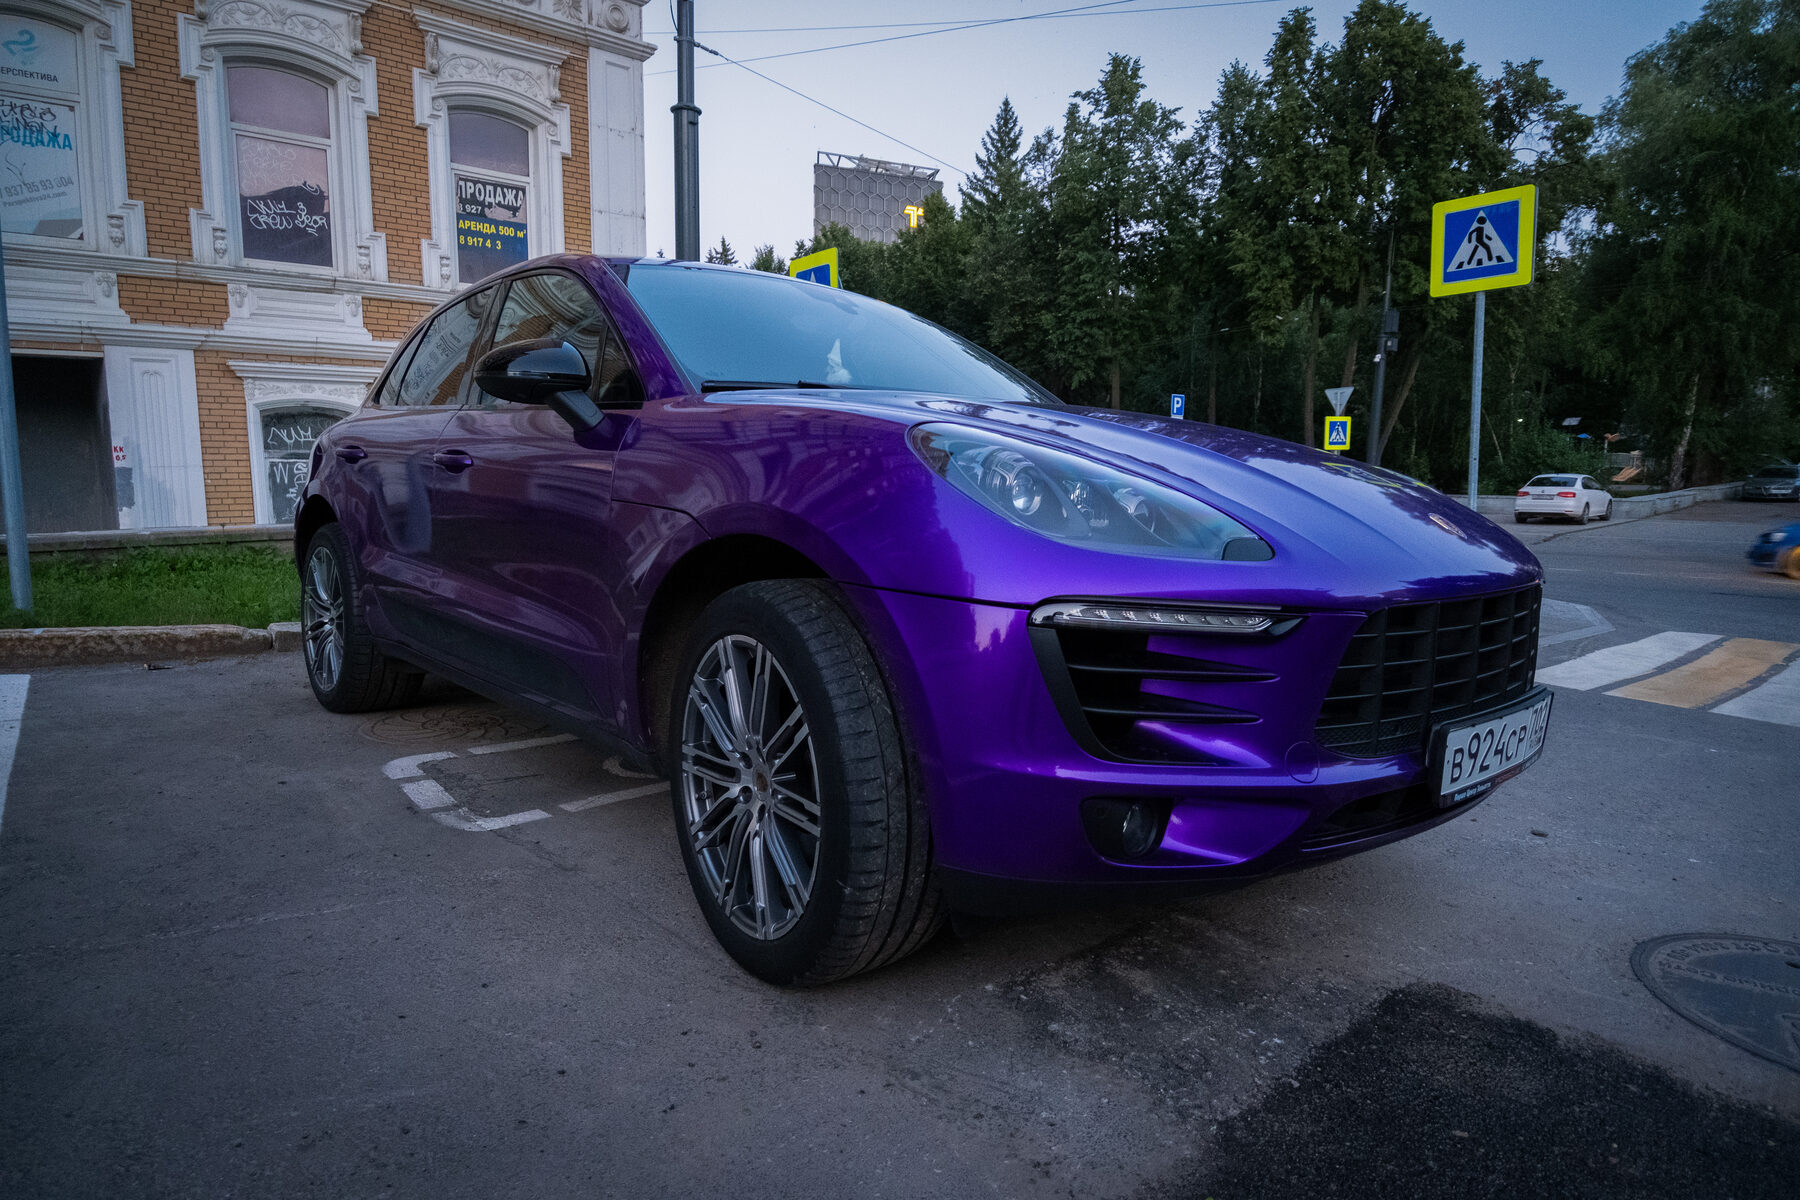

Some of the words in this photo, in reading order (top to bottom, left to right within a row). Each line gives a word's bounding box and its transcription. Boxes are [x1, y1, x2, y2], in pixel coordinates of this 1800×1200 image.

[458, 180, 524, 207] ПРОДАЖА
[465, 204, 482, 214] 927
[458, 219, 497, 235] АРЕНДА
[498, 225, 515, 237] 500
[459, 235, 465, 245] 8
[467, 236, 483, 247] 917
[1173, 397, 1182, 414] P
